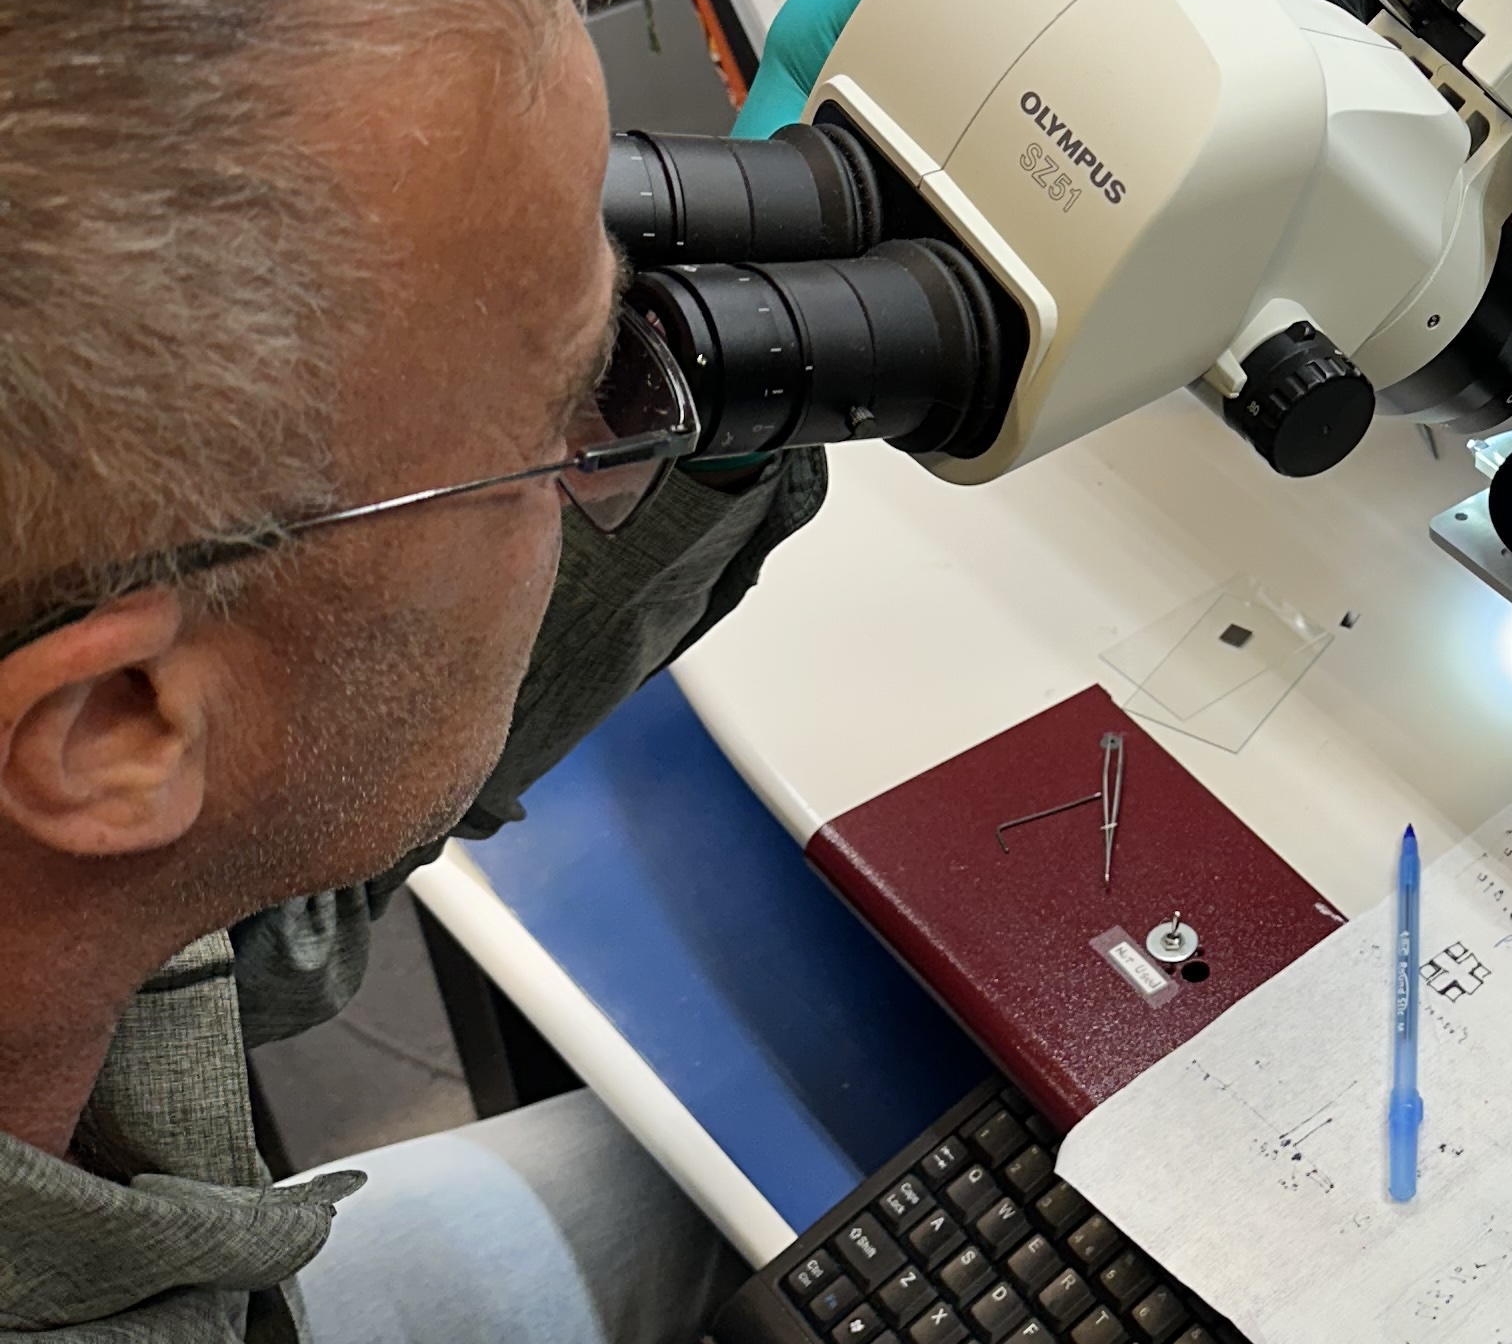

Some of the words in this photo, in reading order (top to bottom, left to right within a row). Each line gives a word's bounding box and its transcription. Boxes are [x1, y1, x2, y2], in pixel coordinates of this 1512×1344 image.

[1020, 91, 1126, 204] OLYMPUS
[1019, 143, 1082, 213] SZ51
[968, 1168, 983, 1183] Q
[900, 1182, 919, 1204] Caps
[886, 1194, 905, 1215] Lock
[998, 1203, 1015, 1220] W
[930, 1217, 945, 1231] A
[858, 1234, 877, 1258] Shift
[1028, 1237, 1043, 1253] E
[961, 1249, 976, 1264] S
[899, 1271, 916, 1288] Z
[1061, 1274, 1077, 1290] R
[992, 1286, 1007, 1301] D
[931, 1307, 948, 1325] X
[1095, 1310, 1109, 1325] T
[1022, 1322, 1039, 1337] F
